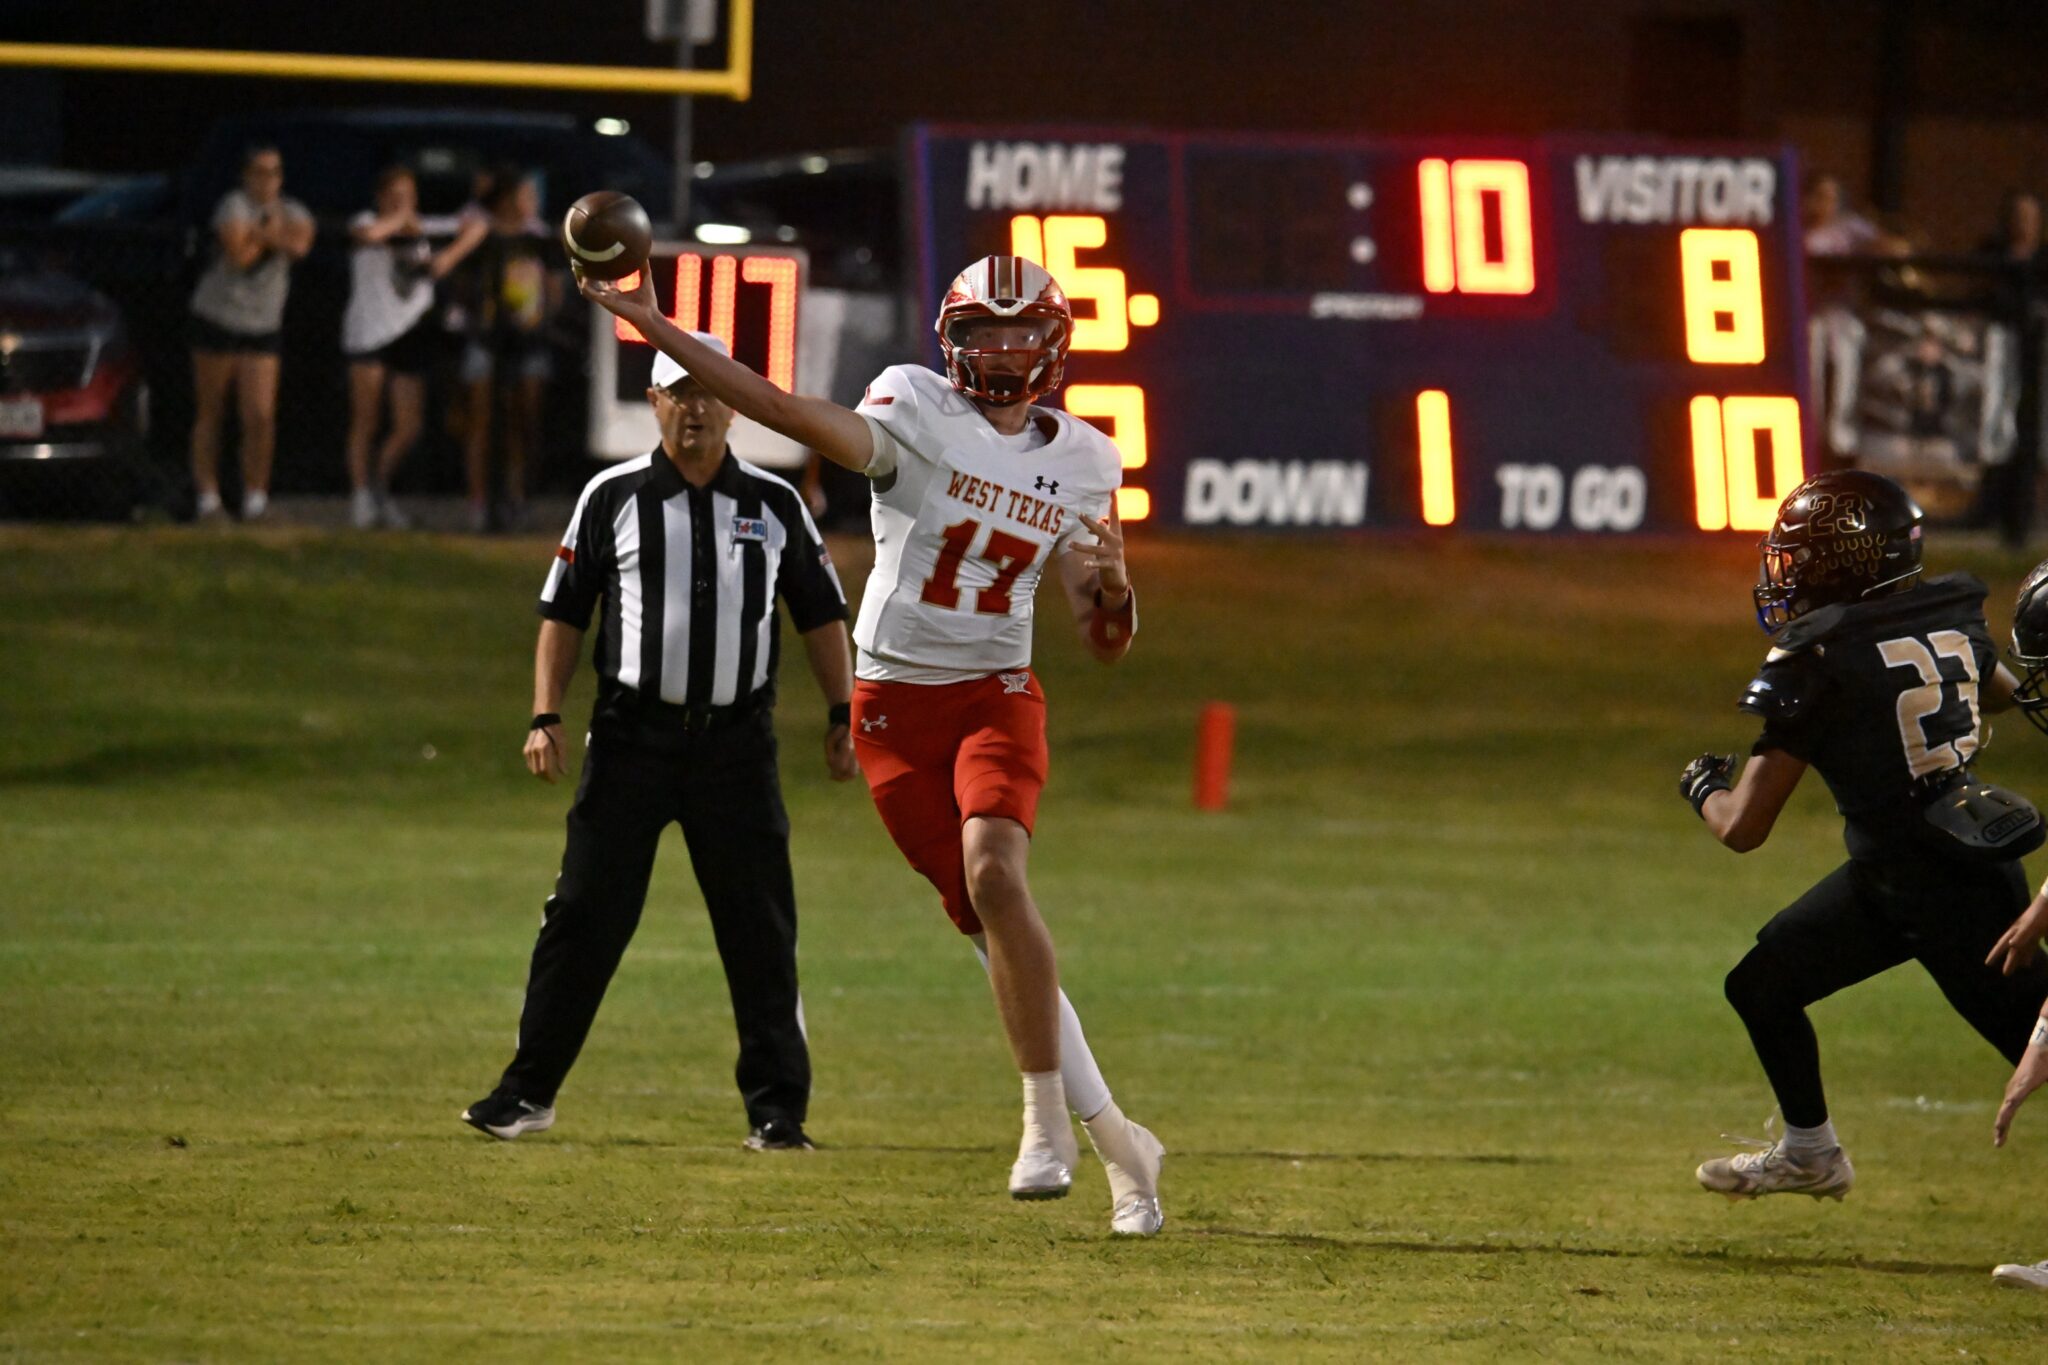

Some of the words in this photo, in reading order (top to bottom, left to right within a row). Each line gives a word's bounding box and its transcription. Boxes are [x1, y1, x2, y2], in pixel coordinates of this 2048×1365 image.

[967, 142, 1125, 209] HOME
[1574, 155, 1776, 223] VISITOR
[1418, 158, 1535, 294] 10
[1680, 228, 1765, 364] 8
[1183, 458, 1369, 526] DOWN
[1416, 389, 1456, 526] 1
[1496, 463, 1564, 529] TO
[1569, 465, 1647, 531] GO
[1689, 394, 1805, 532] 10
[946, 470, 1004, 513] WEST
[1006, 489, 1065, 536] TEXAS
[1807, 492, 1867, 537] 23
[919, 517, 1041, 616] 17
[1876, 629, 1980, 781] 23
